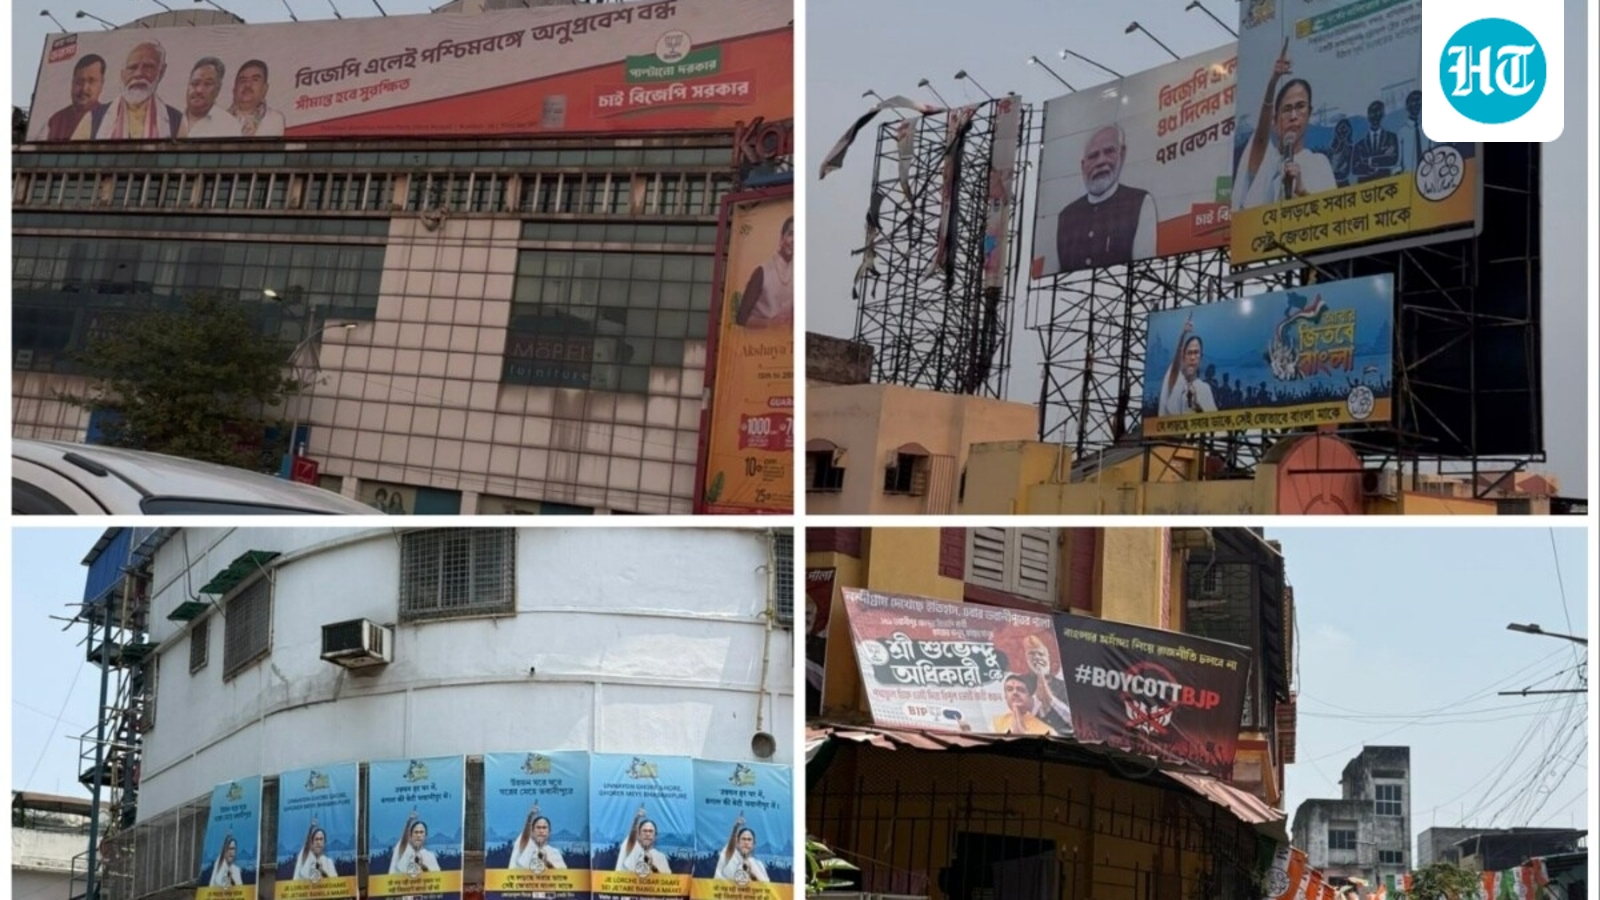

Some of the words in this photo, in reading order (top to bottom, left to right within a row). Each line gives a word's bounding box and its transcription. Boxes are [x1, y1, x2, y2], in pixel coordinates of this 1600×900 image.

[295, 58, 361, 88] বিজেপি
[364, 47, 418, 75] এলেই
[420, 30, 526, 64] পশ্চিমবঙ্গে
[531, 7, 634, 44] অনুপ্রবেশ
[637, 0, 678, 21] বন্ধ
[678, 58, 717, 74] দরকার
[295, 92, 334, 111] সীমান্ত
[335, 89, 358, 103] হবে
[359, 77, 412, 103] সুরক্ষিত
[598, 90, 624, 108] চাই
[629, 82, 687, 105] বিজেপি
[691, 81, 750, 99] সরকার
[1158, 68, 1208, 111] বিজেপি
[1179, 99, 1221, 127] দিনের
[1179, 124, 1219, 157] বেতন
[1262, 207, 1277, 226] যে
[1280, 200, 1320, 222] লড়ছে
[1323, 192, 1357, 213] সবার
[1362, 181, 1399, 204] ডাকে
[1280, 222, 1329, 245] জেতাবে
[1332, 216, 1369, 236] বাংলা
[1374, 206, 1411, 227] মাকে
[1299, 322, 1354, 350] জিতবে
[1299, 347, 1354, 375] বাংলা
[1290, 409, 1314, 421] বাংলা
[1316, 407, 1341, 419] মাকে
[886, 632, 916, 661] শ্রী
[918, 640, 1001, 669] শুভেন্দু
[1157, 645, 1197, 662] রাজনীতি
[1199, 654, 1224, 668] চলবে
[1226, 659, 1238, 671] না
[890, 659, 983, 687] অধিকারী
